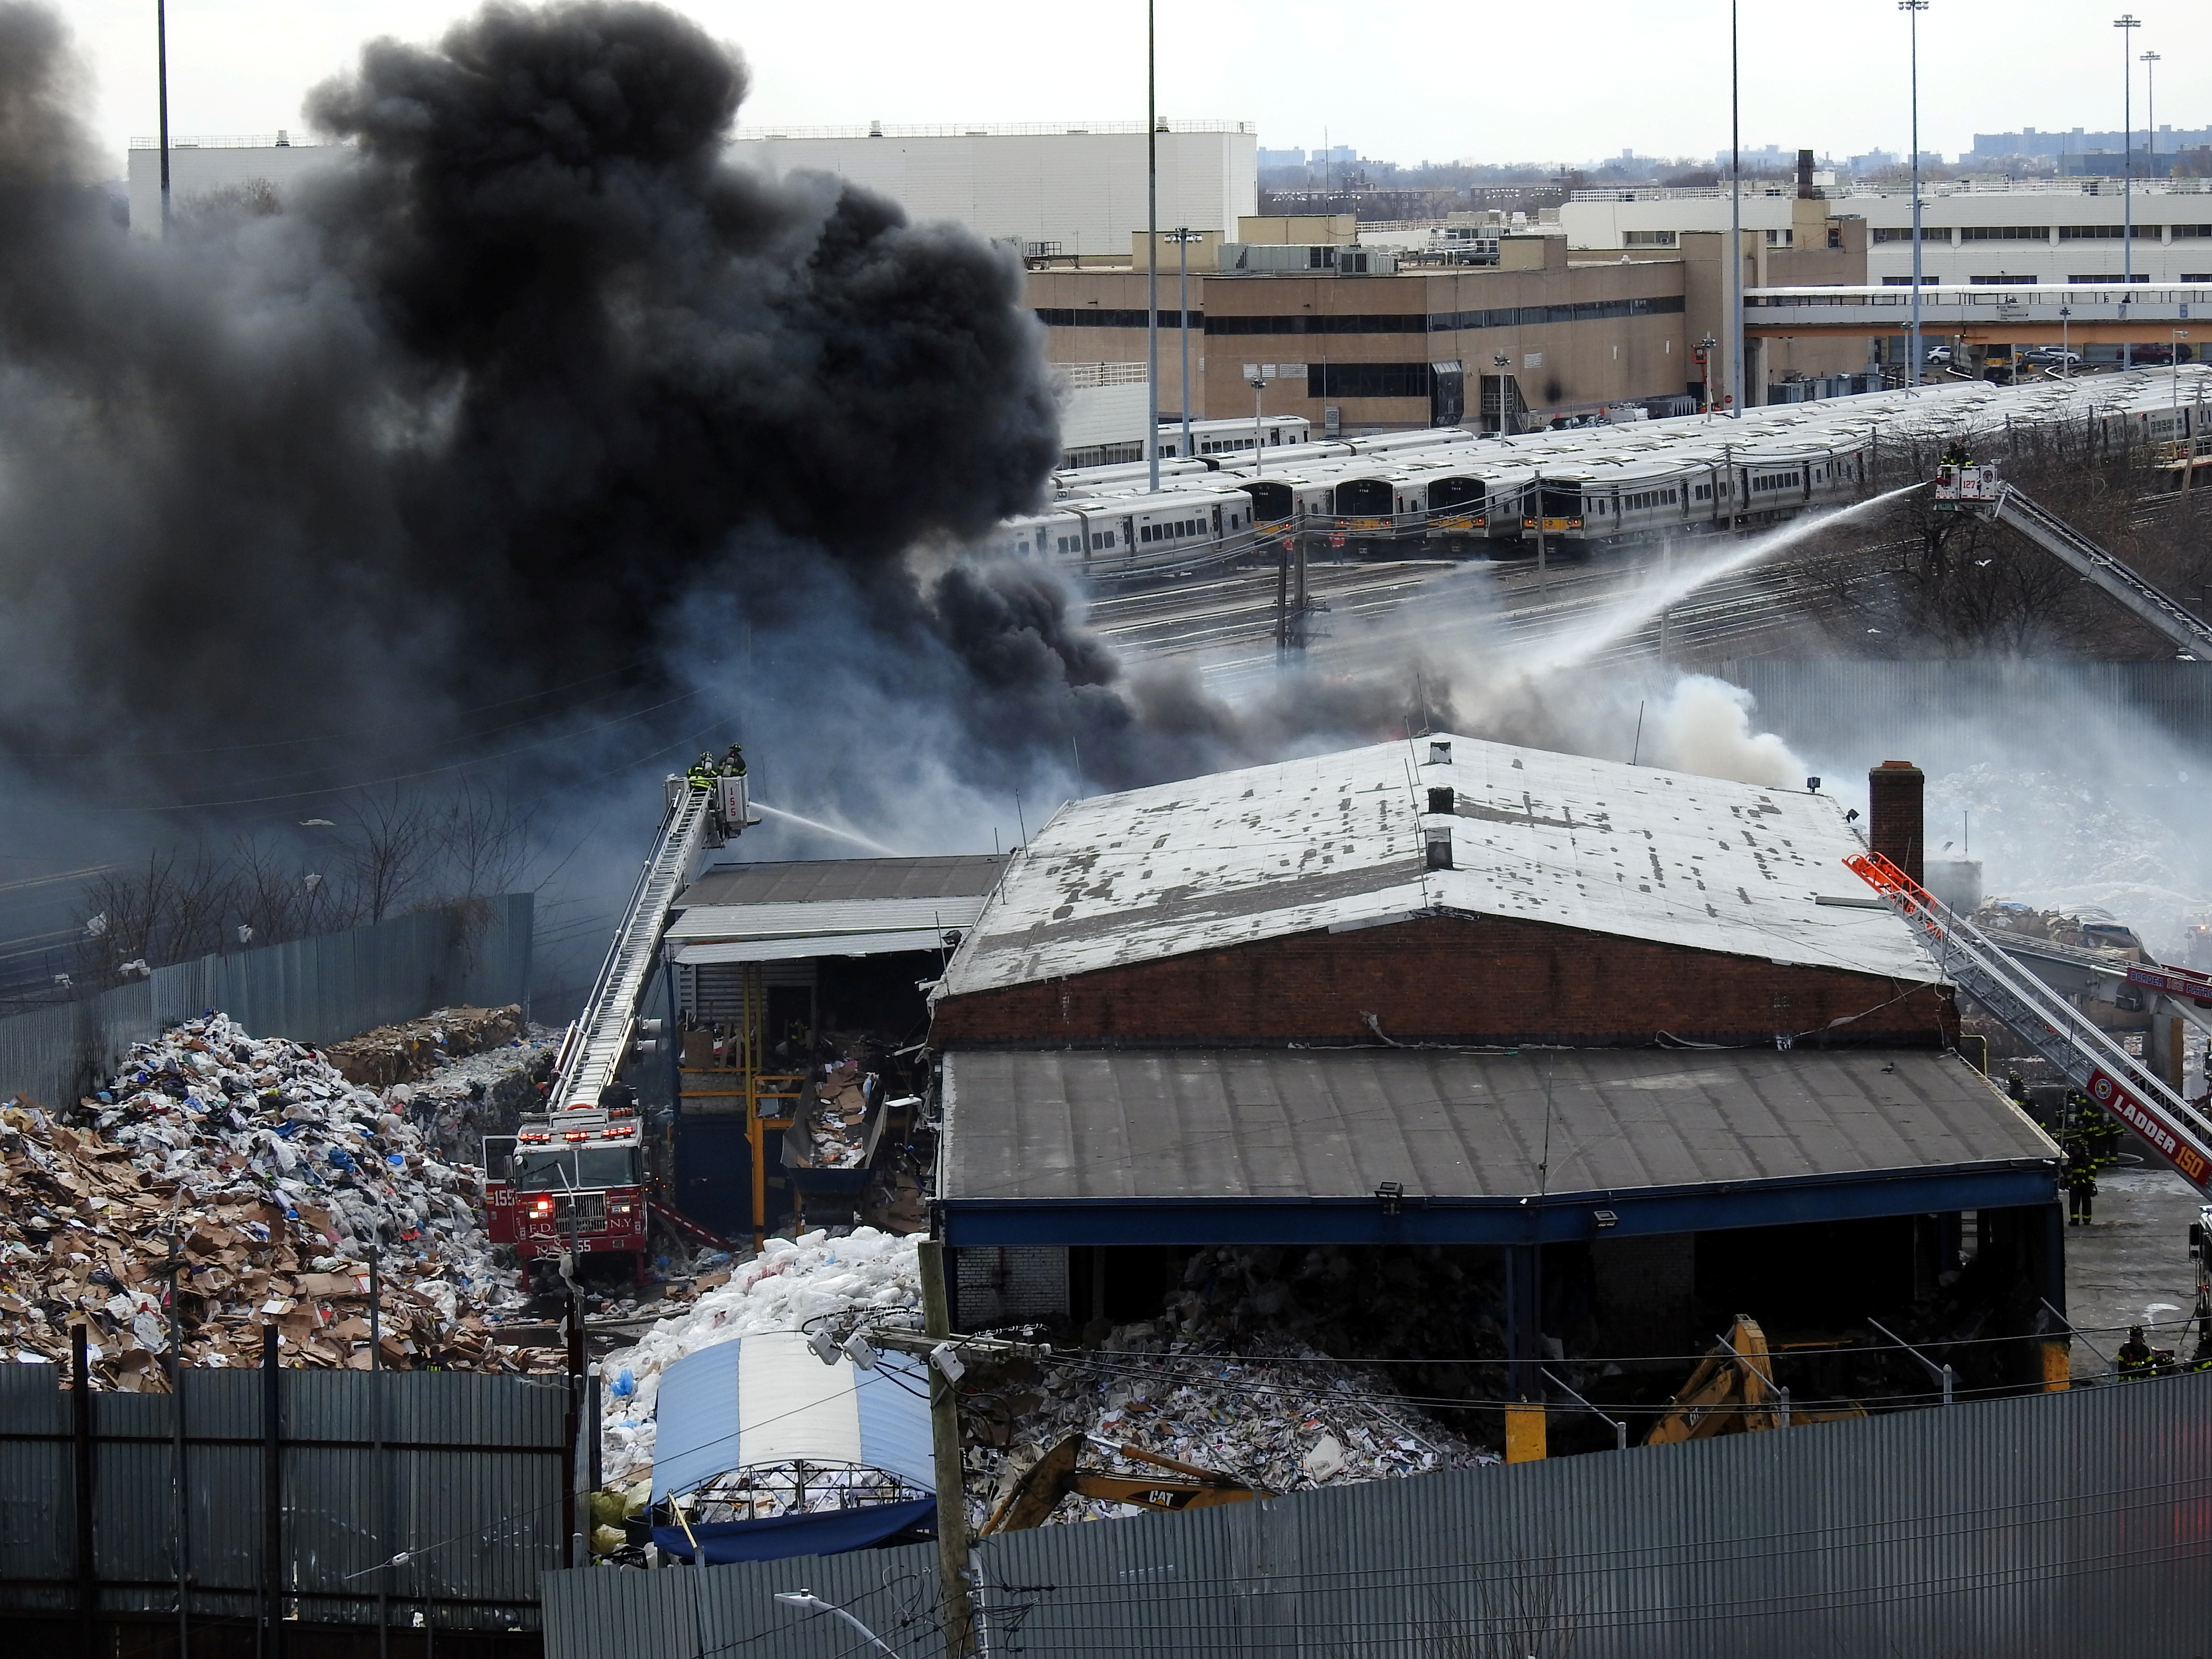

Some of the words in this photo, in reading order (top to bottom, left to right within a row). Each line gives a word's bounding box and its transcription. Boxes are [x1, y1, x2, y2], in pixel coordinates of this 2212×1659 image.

[2118, 305, 2127, 319] 7
[2179, 304, 2188, 318] 6
[1963, 480, 1975, 489] 127
[2131, 971, 2164, 987] BORDER
[2166, 977, 2184, 992] 162
[2114, 1094, 2176, 1154] LADDER
[2175, 1146, 2204, 1178] 150
[494, 1190, 515, 1206] 155
[529, 1223, 553, 1233] F.D.
[577, 1239, 591, 1252] 55
[1149, 1490, 1174, 1507] CAT
